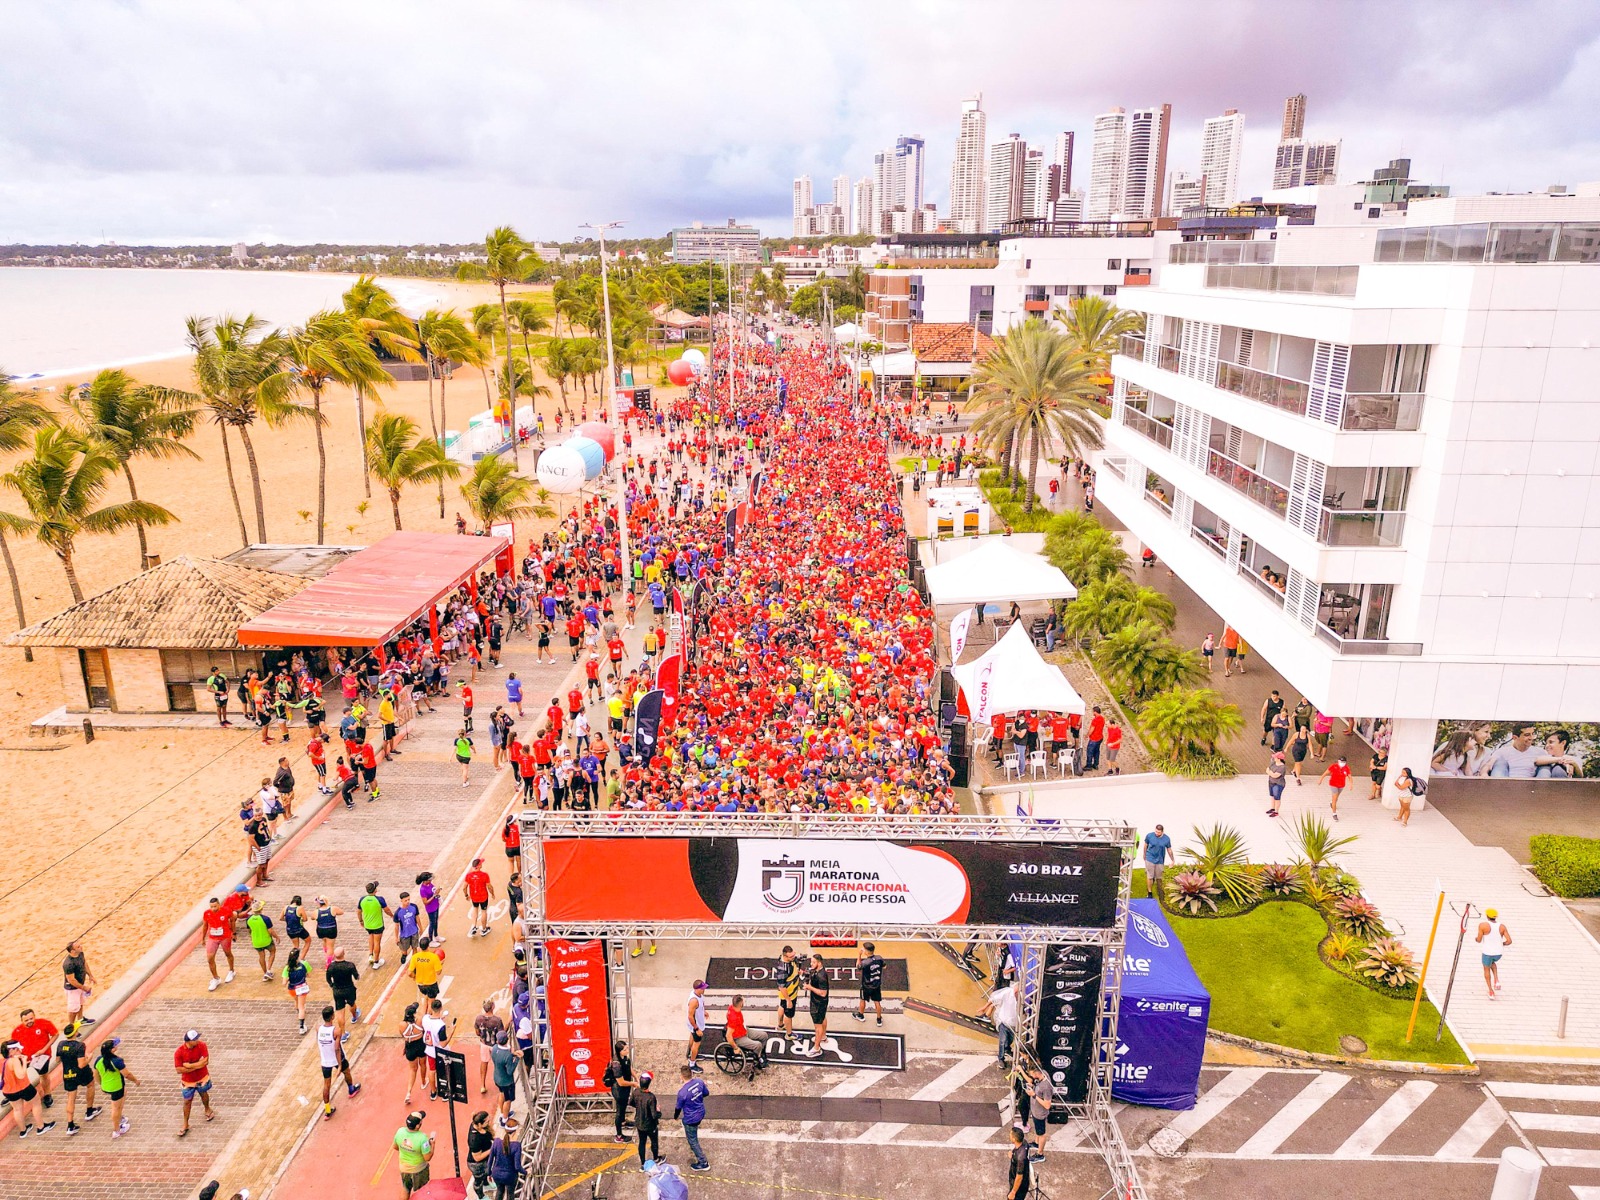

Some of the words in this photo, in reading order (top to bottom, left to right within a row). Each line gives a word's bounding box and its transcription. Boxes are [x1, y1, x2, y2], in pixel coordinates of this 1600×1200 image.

[979, 682, 988, 718] FALCON
[809, 860, 840, 869] MEIA
[1008, 862, 1039, 875] SÃO
[1041, 864, 1083, 876] BRAZ
[809, 871, 880, 881] MARATONA
[809, 882, 910, 893] INTERNACIONAL
[809, 893, 825, 903] DE
[827, 891, 857, 904] JOÃO
[860, 894, 906, 904] PESSOA
[1007, 892, 1079, 904] ALLIANCE
[1069, 954, 1087, 962] RUN
[1151, 1001, 1187, 1010] zenite
